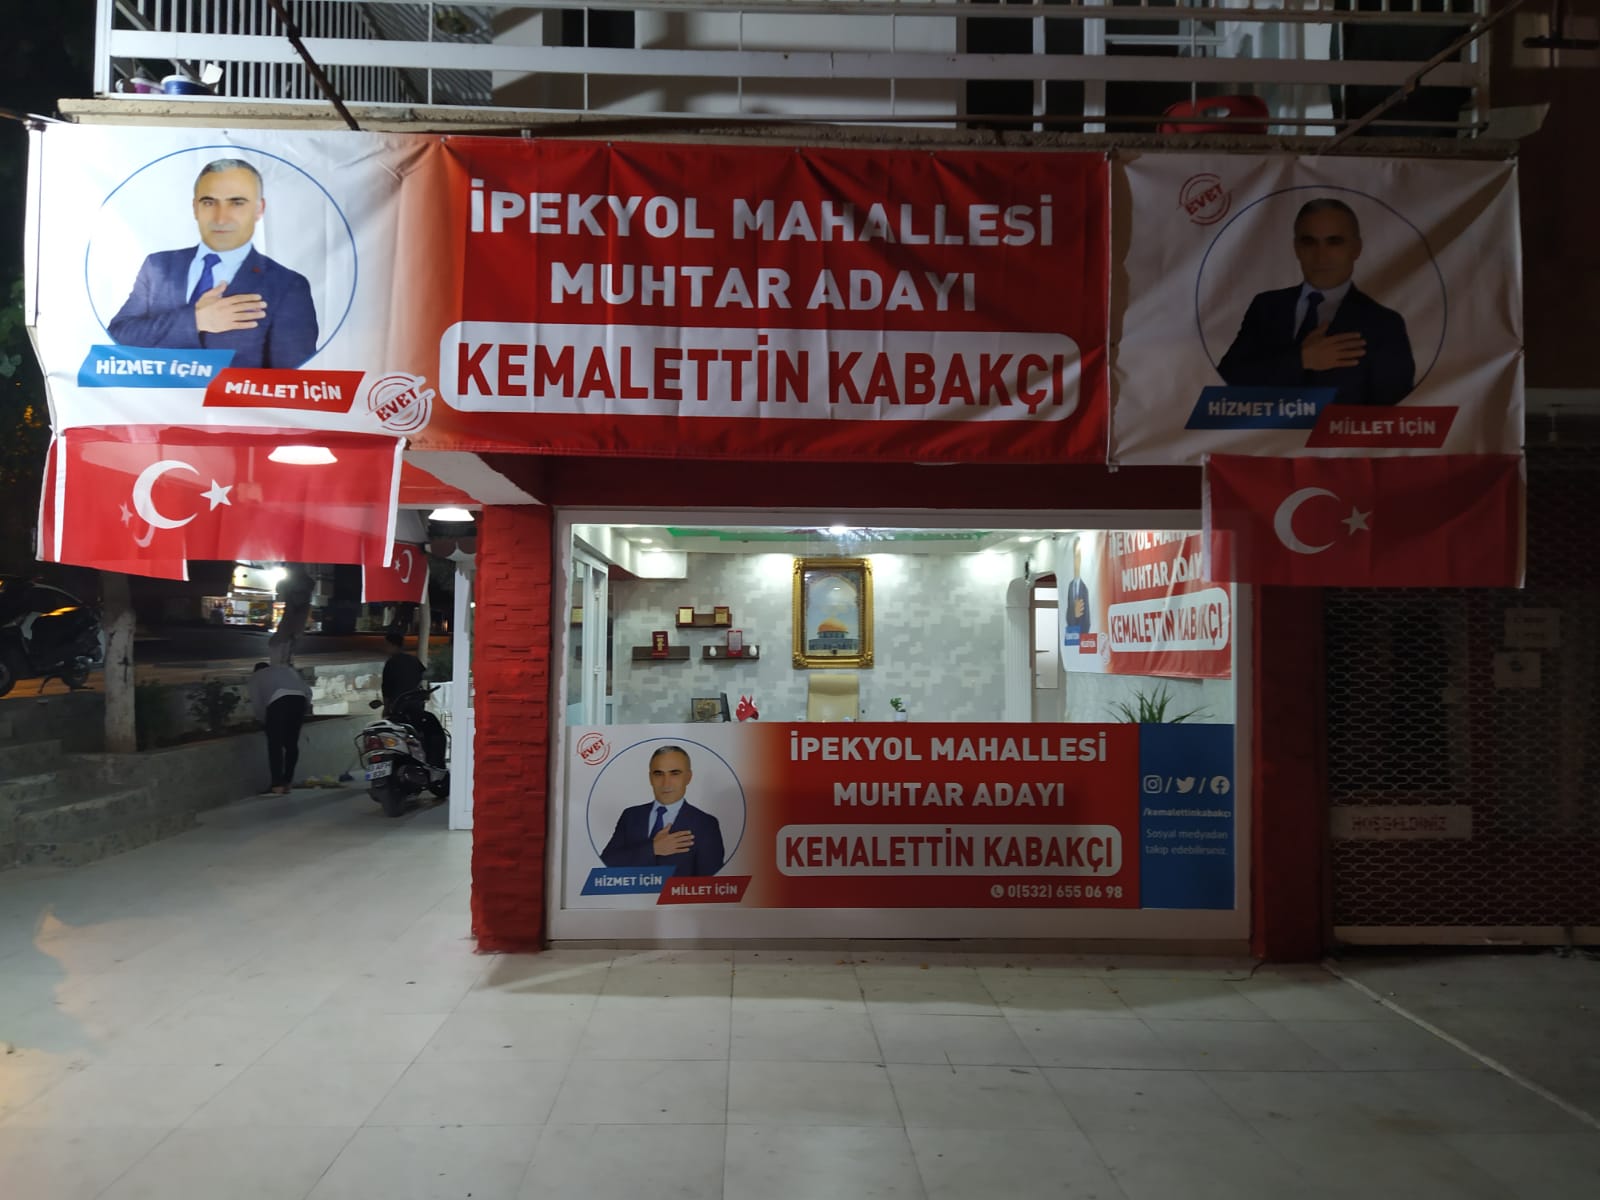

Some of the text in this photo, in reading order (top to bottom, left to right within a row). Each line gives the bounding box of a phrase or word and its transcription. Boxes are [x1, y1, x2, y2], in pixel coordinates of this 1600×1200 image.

[470, 178, 1053, 246] İPEKYOL MAHALLESİ
[1185, 183, 1223, 216] EVET
[551, 262, 976, 311] MUHTAR ADAYI
[95, 356, 213, 378] HİZMET İÇİN
[457, 334, 1065, 415] KEMALETTİN KABAKÇI
[225, 380, 342, 402] MİLLET İÇİN
[375, 387, 417, 422] EVET
[1208, 400, 1316, 418] HİZMET İÇİN
[1329, 416, 1436, 437] MİLLET İÇİN
[1121, 560, 1169, 592] MUHTAR
[580, 738, 606, 760] EVET
[790, 731, 1107, 762] İPEKYOL MAHALLESİ
[833, 782, 1065, 807] MUHTAR ADAYI
[785, 827, 1113, 873] KEMALETTİN KABAKÇI
[594, 874, 662, 888] HİZMET İÇİN
[671, 884, 738, 896] MİLLET İÇİN
[1056, 885, 1081, 898] 655
[1085, 885, 1102, 898] 06
[1105, 886, 1123, 899] 98
